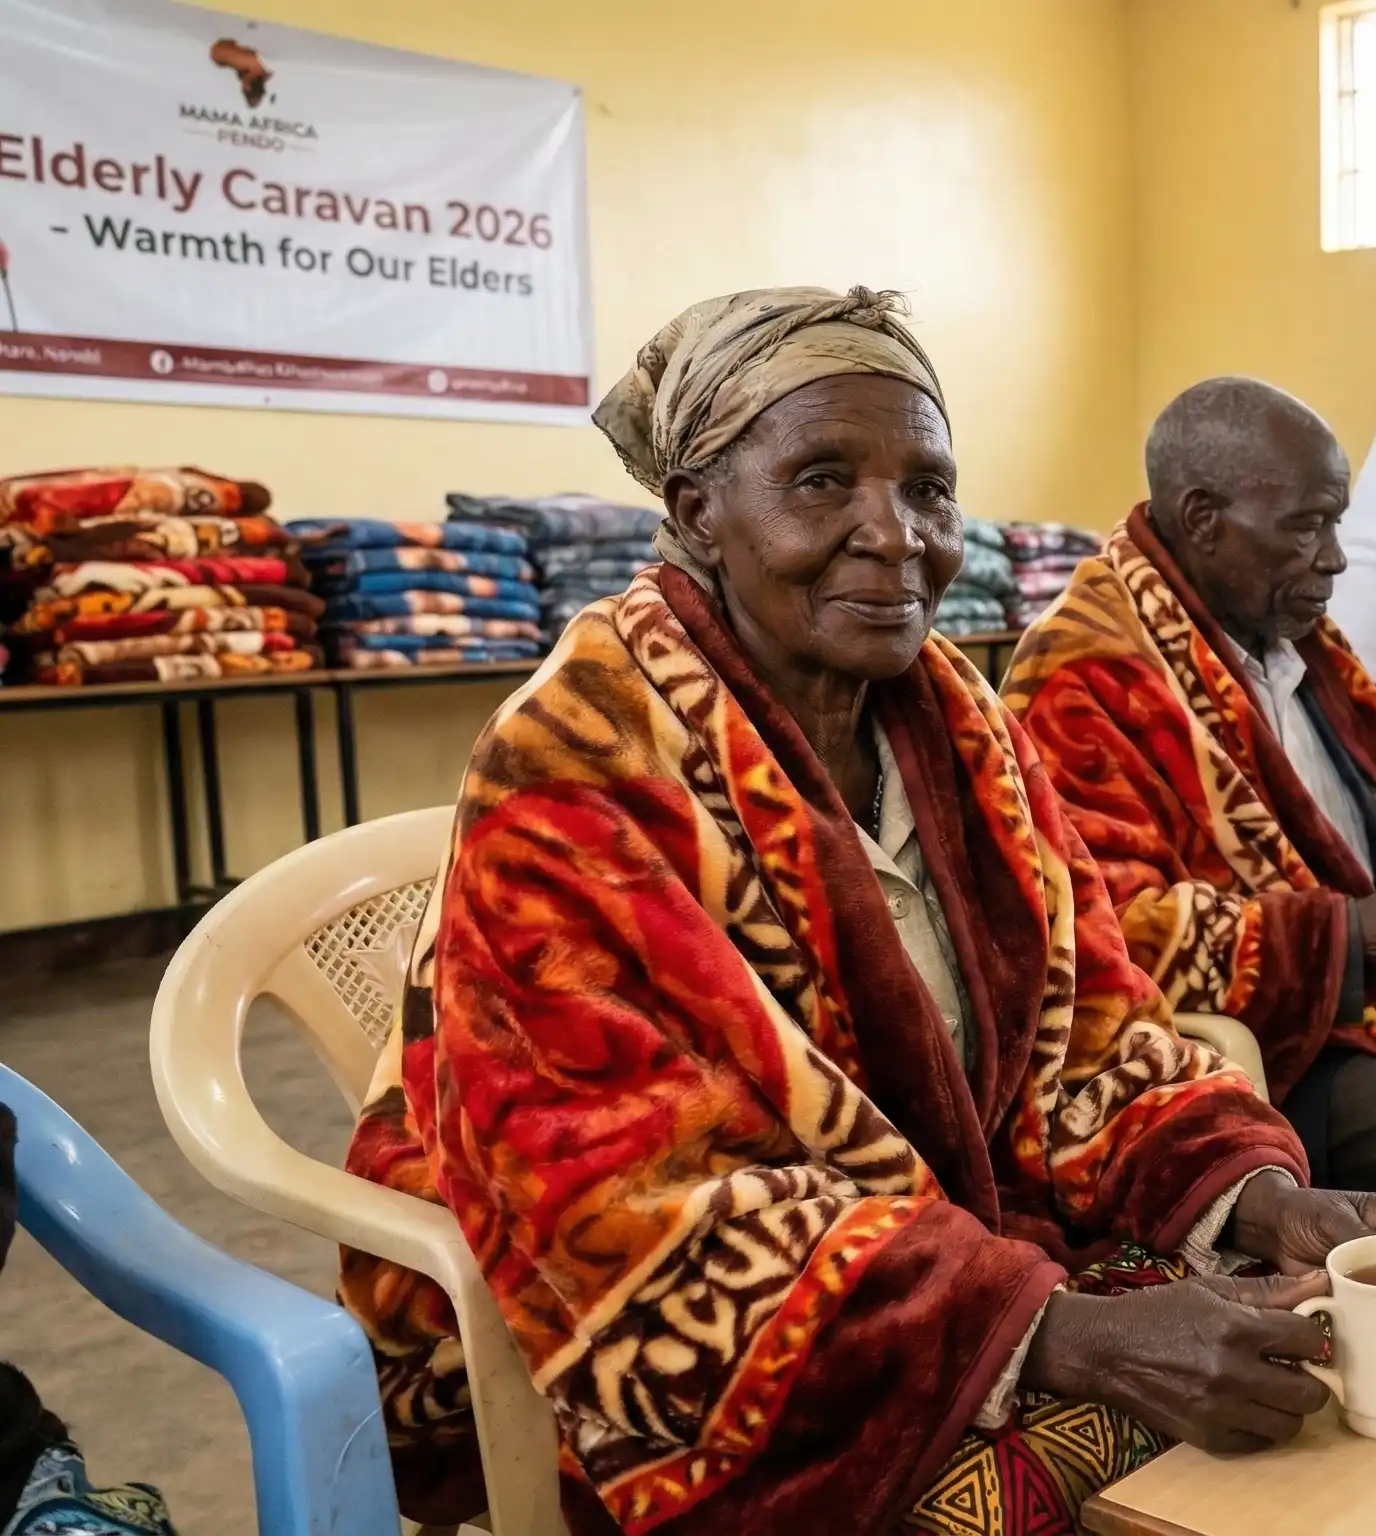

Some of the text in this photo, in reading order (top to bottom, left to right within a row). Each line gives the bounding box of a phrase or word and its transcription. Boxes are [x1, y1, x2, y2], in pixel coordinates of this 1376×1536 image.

[179, 103, 319, 140] MAMA AFRICA
[217, 128, 285, 153] PENDO
[0, 133, 552, 251] Elderly Caravan 2026
[83, 213, 265, 266] Warmth
[278, 236, 333, 274] for
[346, 246, 415, 282] Our
[428, 256, 533, 296] Elders
